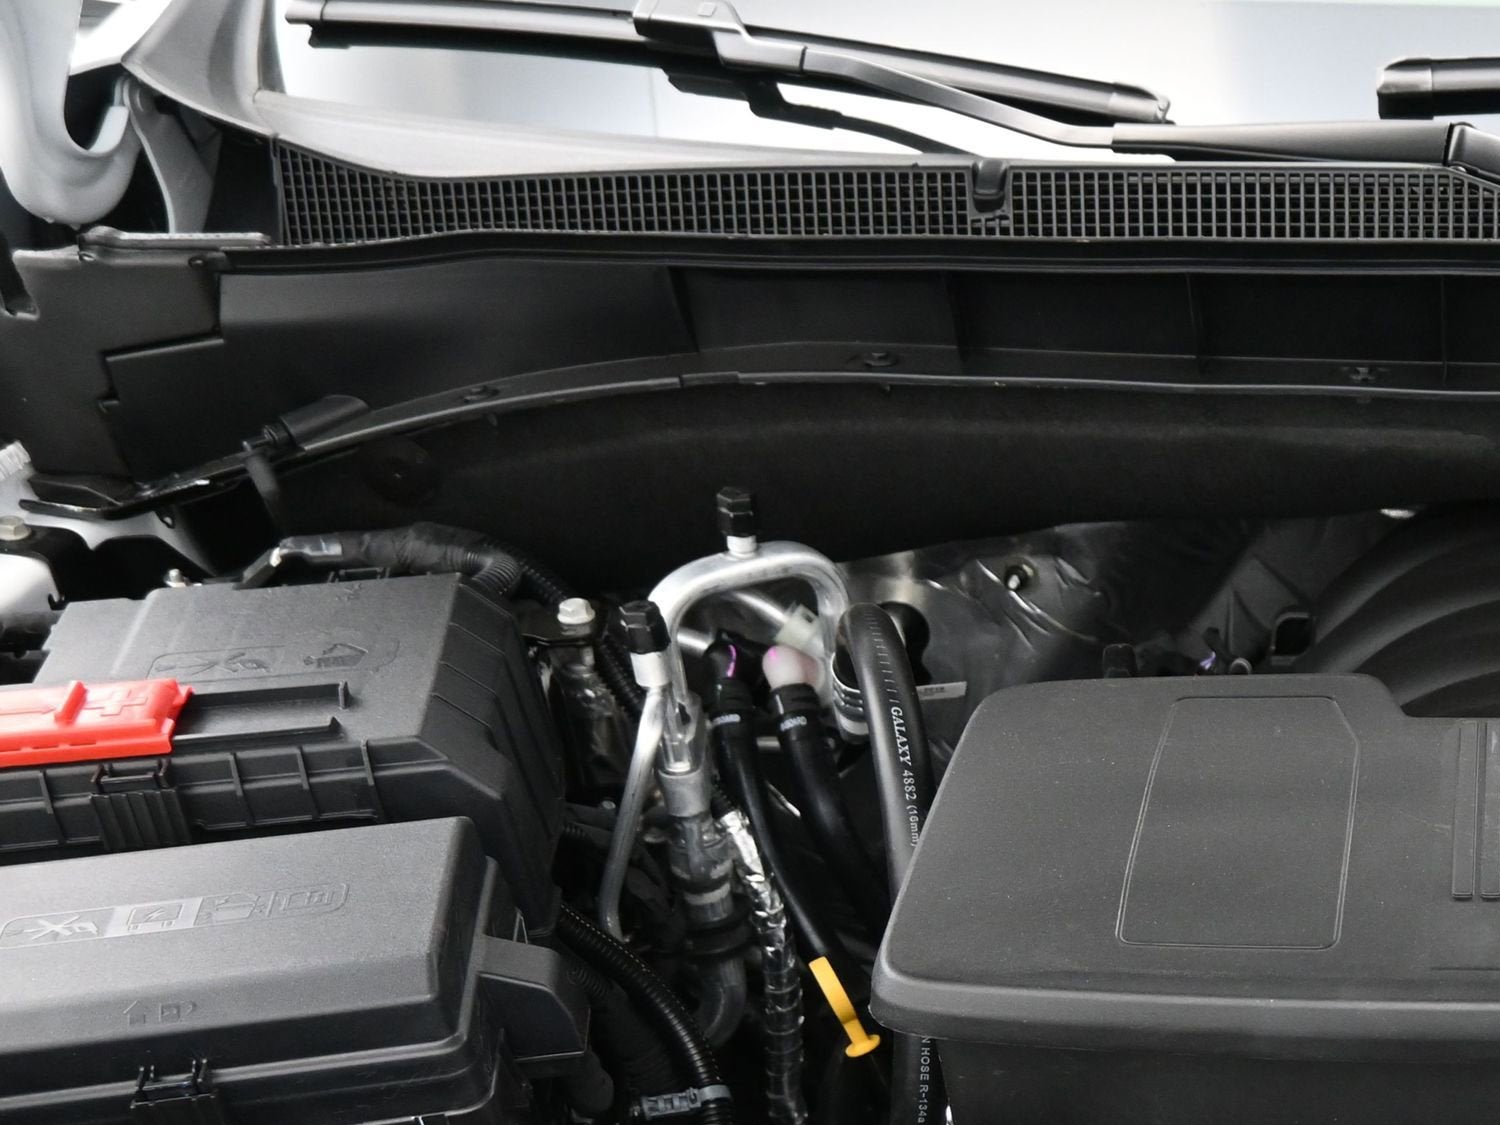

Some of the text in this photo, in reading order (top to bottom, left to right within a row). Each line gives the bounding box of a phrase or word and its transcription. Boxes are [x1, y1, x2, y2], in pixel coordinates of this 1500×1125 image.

[890, 705, 912, 767] GALAXY
[902, 769, 917, 801] 4882
[920, 1047, 931, 1081] HOSE
[917, 1084, 929, 1124] R-134a
